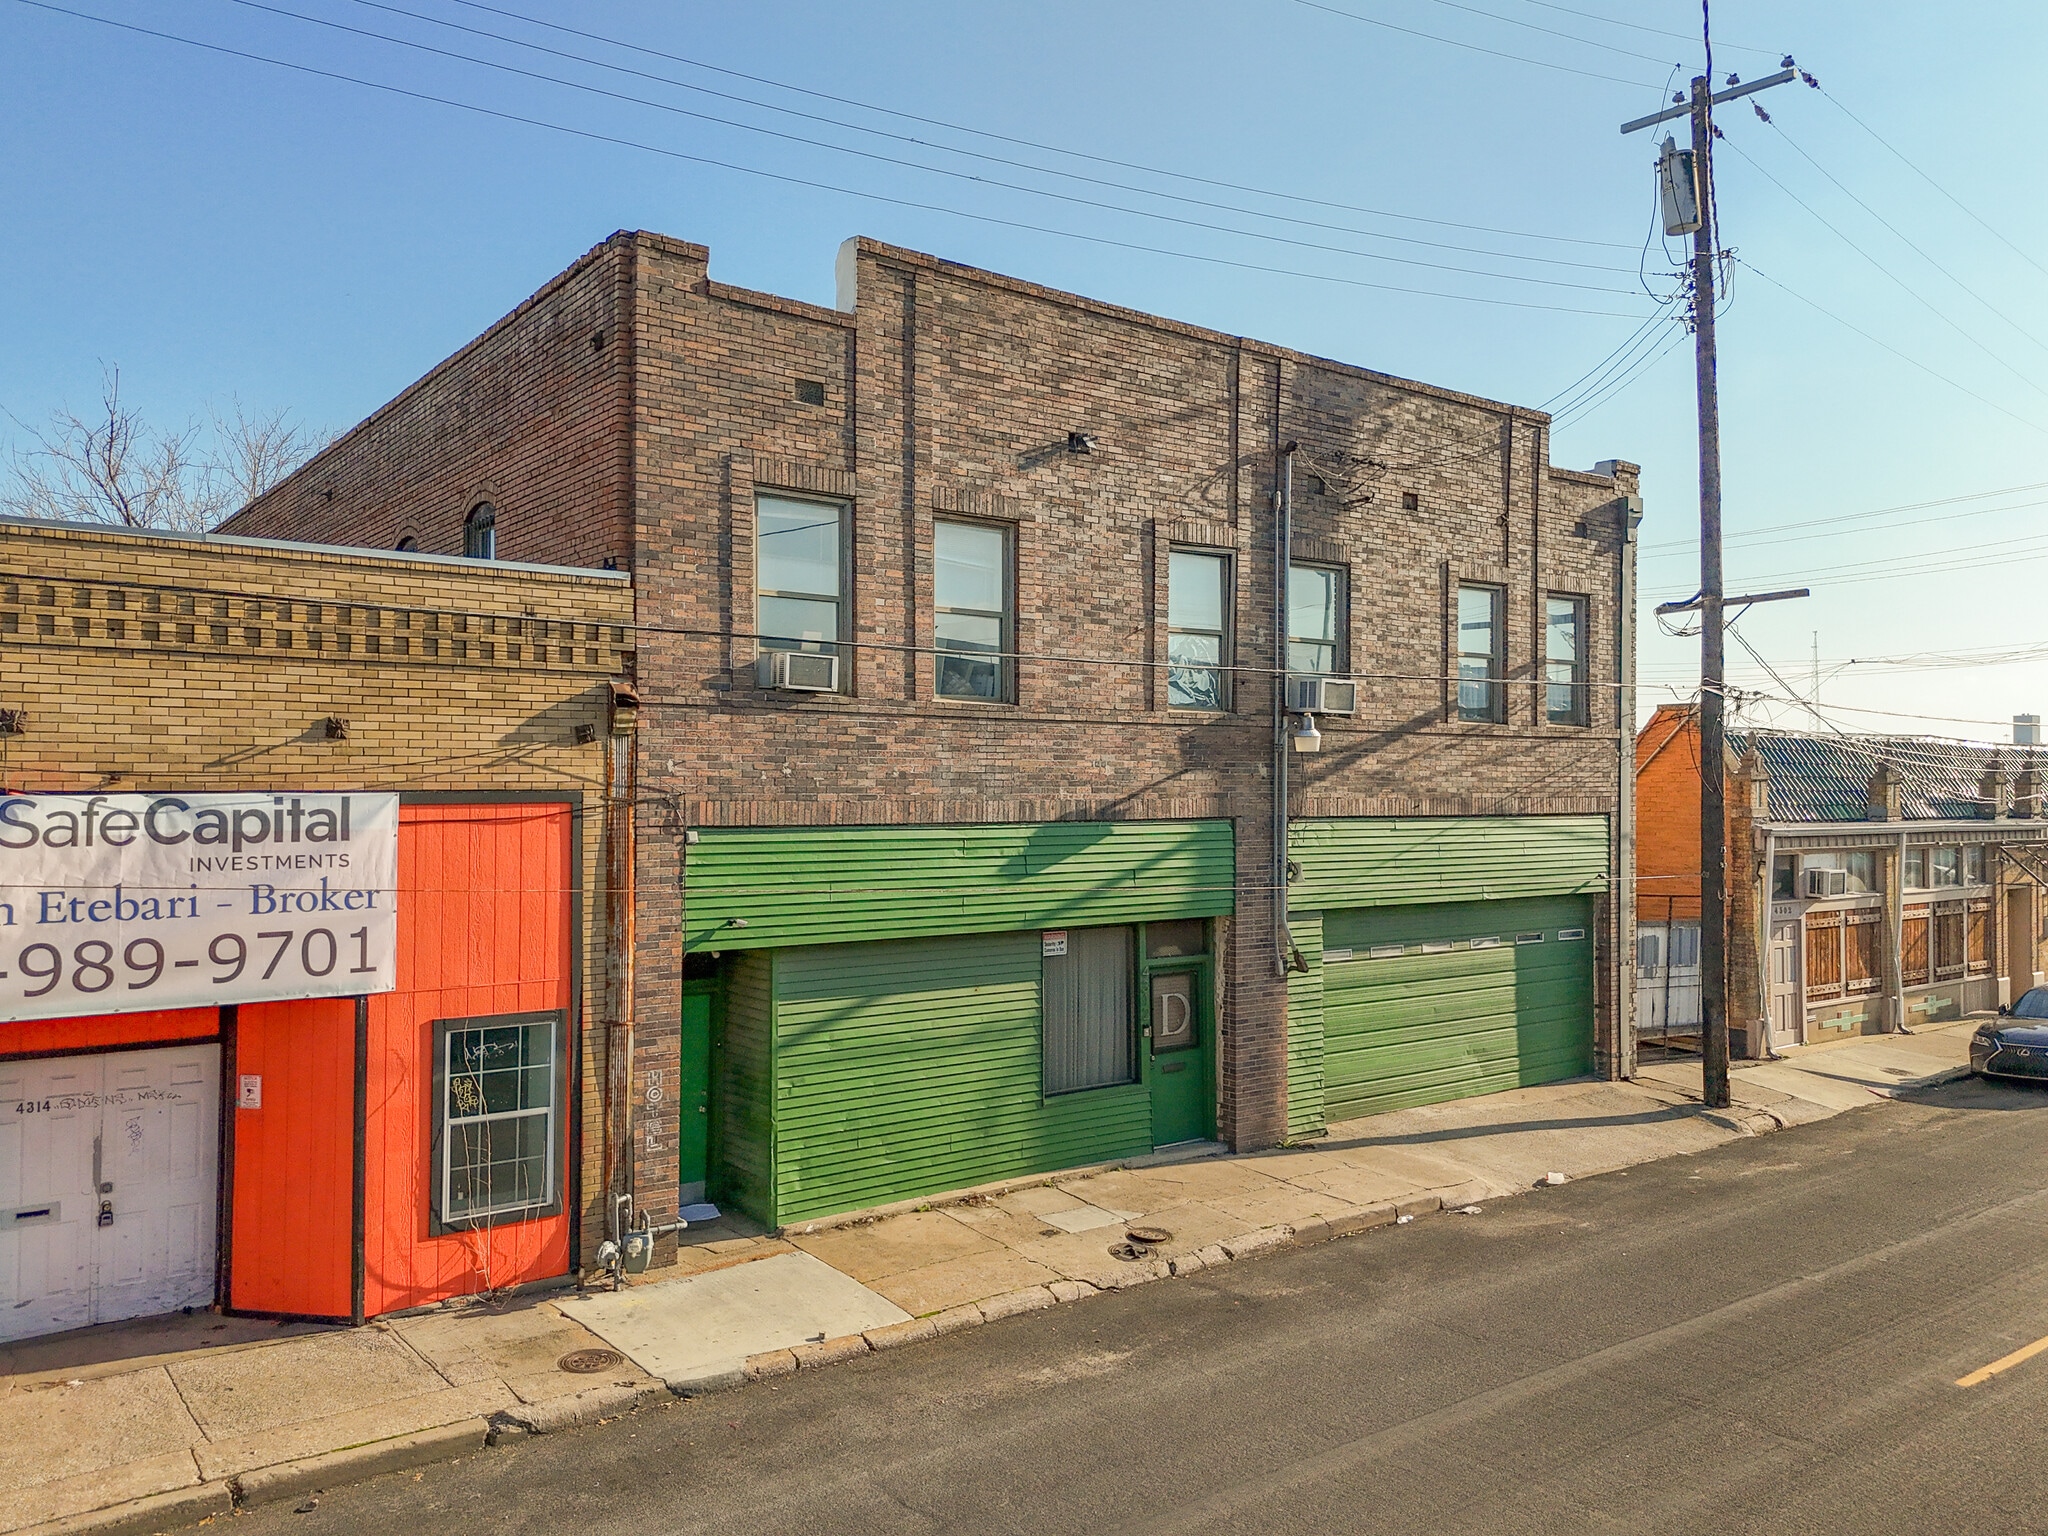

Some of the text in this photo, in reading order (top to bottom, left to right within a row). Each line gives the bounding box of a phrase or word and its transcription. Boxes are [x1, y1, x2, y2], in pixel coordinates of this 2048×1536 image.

[190, 853, 350, 872] INVESTMENTS
[37, 883, 200, 925] Etebari
[249, 876, 380, 914] Broker
[1160, 993, 1191, 1036] D
[16, 1101, 51, 1114] 4314
